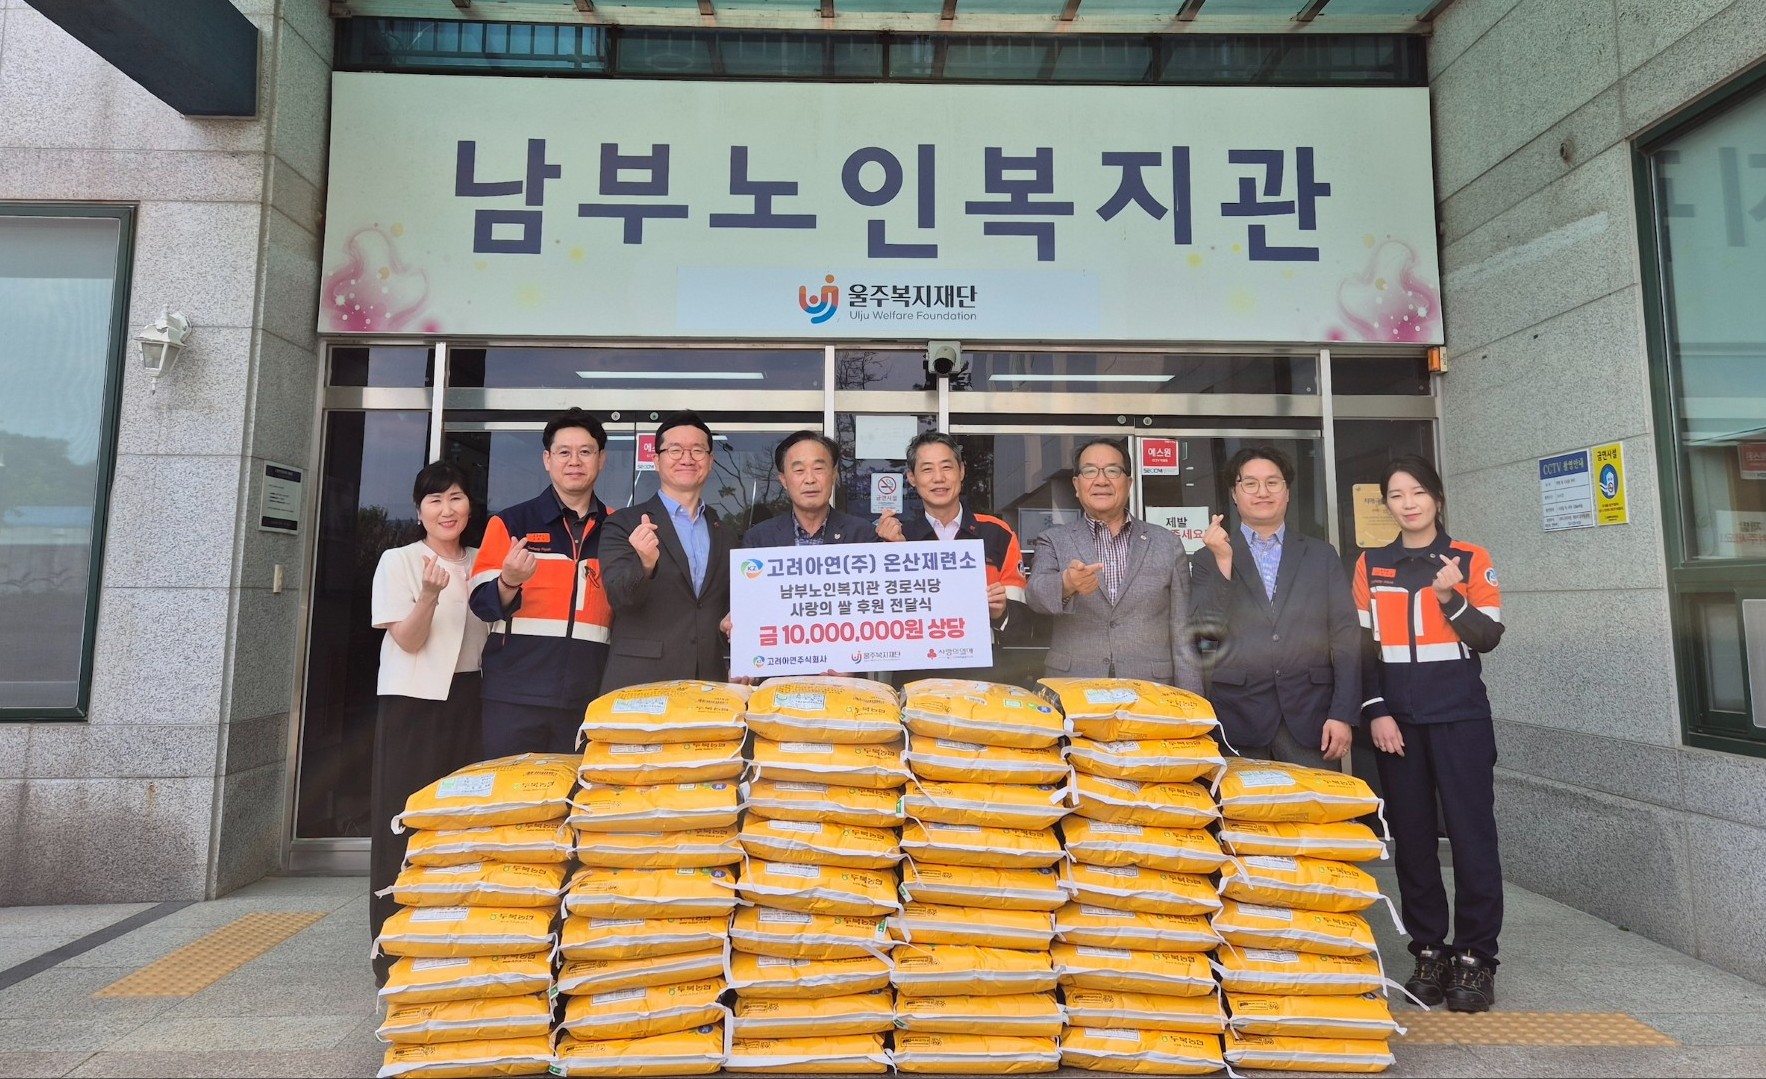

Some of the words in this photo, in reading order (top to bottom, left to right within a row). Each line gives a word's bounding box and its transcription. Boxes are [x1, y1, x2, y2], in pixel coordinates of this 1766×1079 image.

[455, 139, 1331, 262] 남부노인복지관
[848, 284, 977, 308] 울주복지재단
[850, 311, 869, 321] Ulju
[872, 310, 913, 320] Welfare
[916, 311, 977, 320] Foundation
[1147, 447, 1172, 458] 에스원
[1597, 448, 1617, 461] 금연시설
[1543, 462, 1562, 475] CCTV
[1165, 517, 1188, 528] 제발
[767, 554, 876, 578] 고려아연(주)
[883, 551, 977, 573] 온산제련소
[780, 581, 879, 599] 남부노인복지관
[885, 578, 941, 594] 경로식당
[790, 600, 832, 617] 사랑의
[838, 600, 852, 615] 쌀
[857, 599, 884, 614] 후원
[890, 597, 932, 613] 전달식
[759, 626, 778, 646] 금
[927, 618, 965, 639] 상당
[767, 654, 827, 666] 고려아연주식회사
